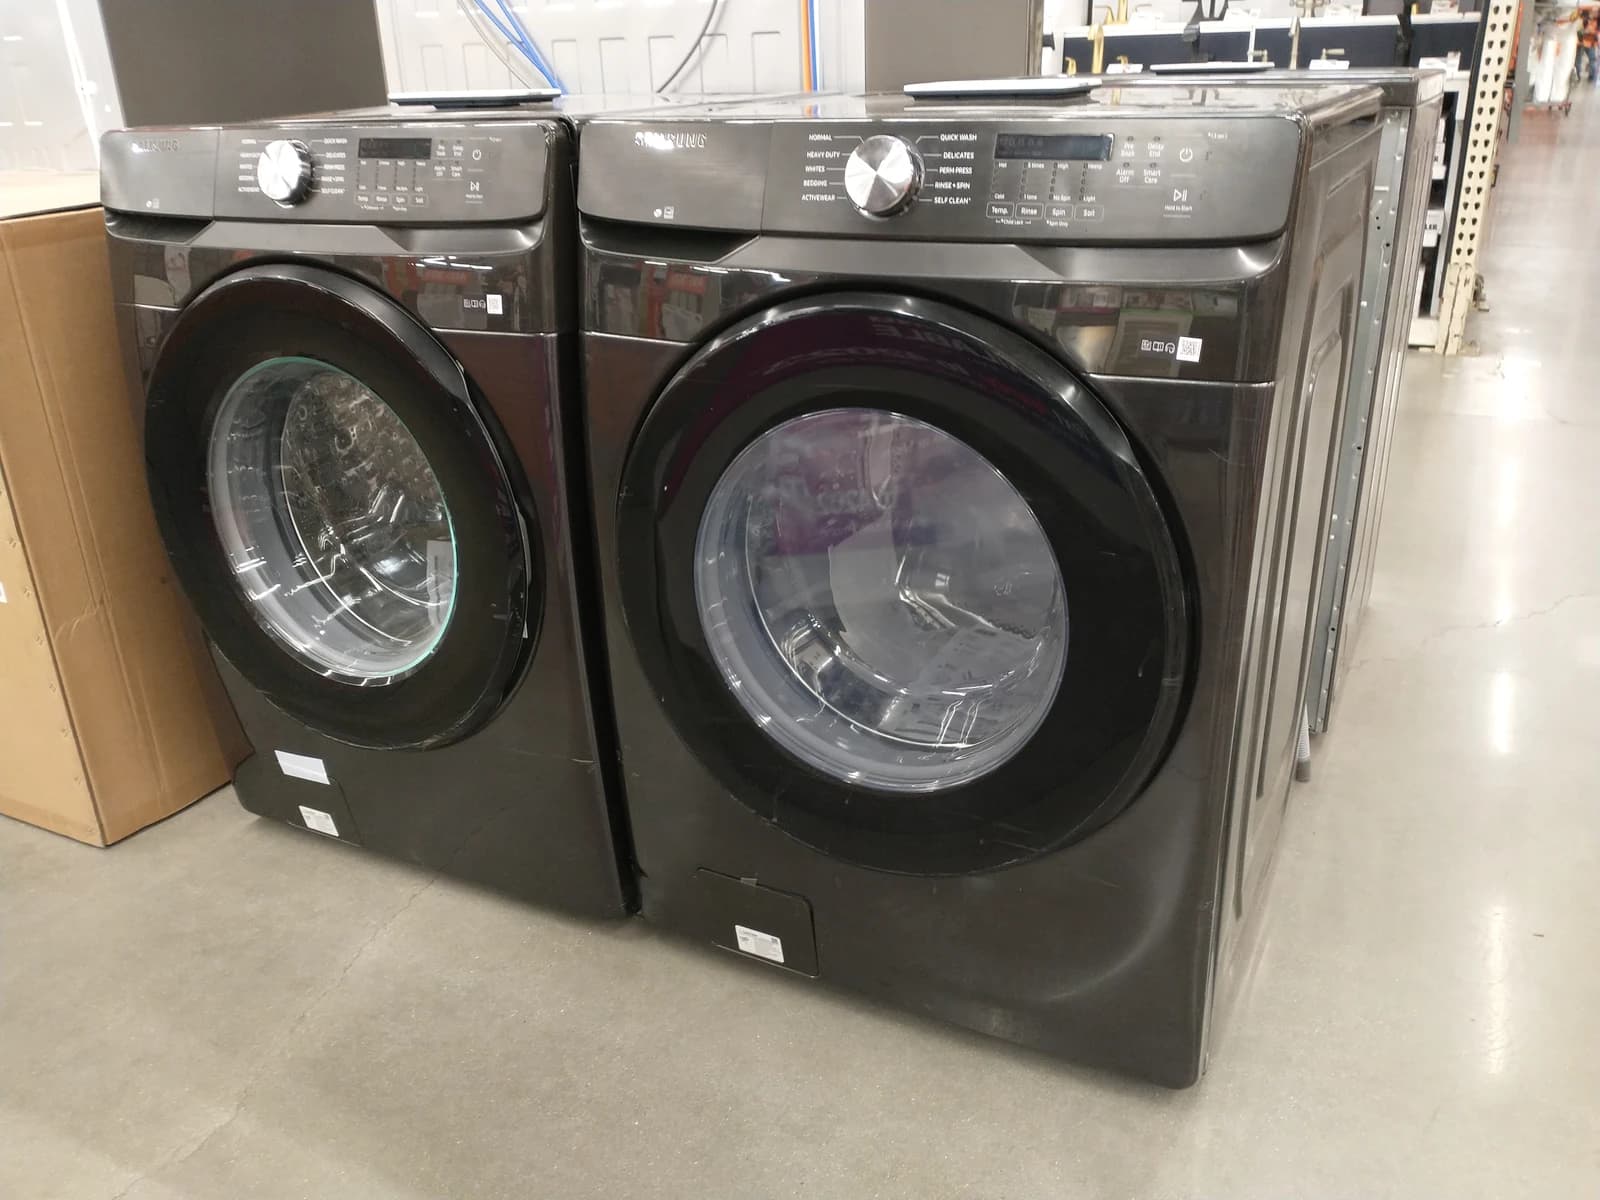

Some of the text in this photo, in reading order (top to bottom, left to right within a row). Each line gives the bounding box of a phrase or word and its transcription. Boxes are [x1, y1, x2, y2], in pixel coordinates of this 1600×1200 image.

[634, 131, 707, 149] SSUNG
[940, 133, 977, 141] QUICK WASH
[131, 139, 179, 153] AMSUNG
[806, 151, 824, 159] HEAVY
[943, 151, 975, 159] DELICATES
[940, 166, 973, 174] PERM PRESS
[803, 179, 827, 187] BEDDING
[934, 181, 952, 189] RINSE
[934, 196, 948, 204] SELF
